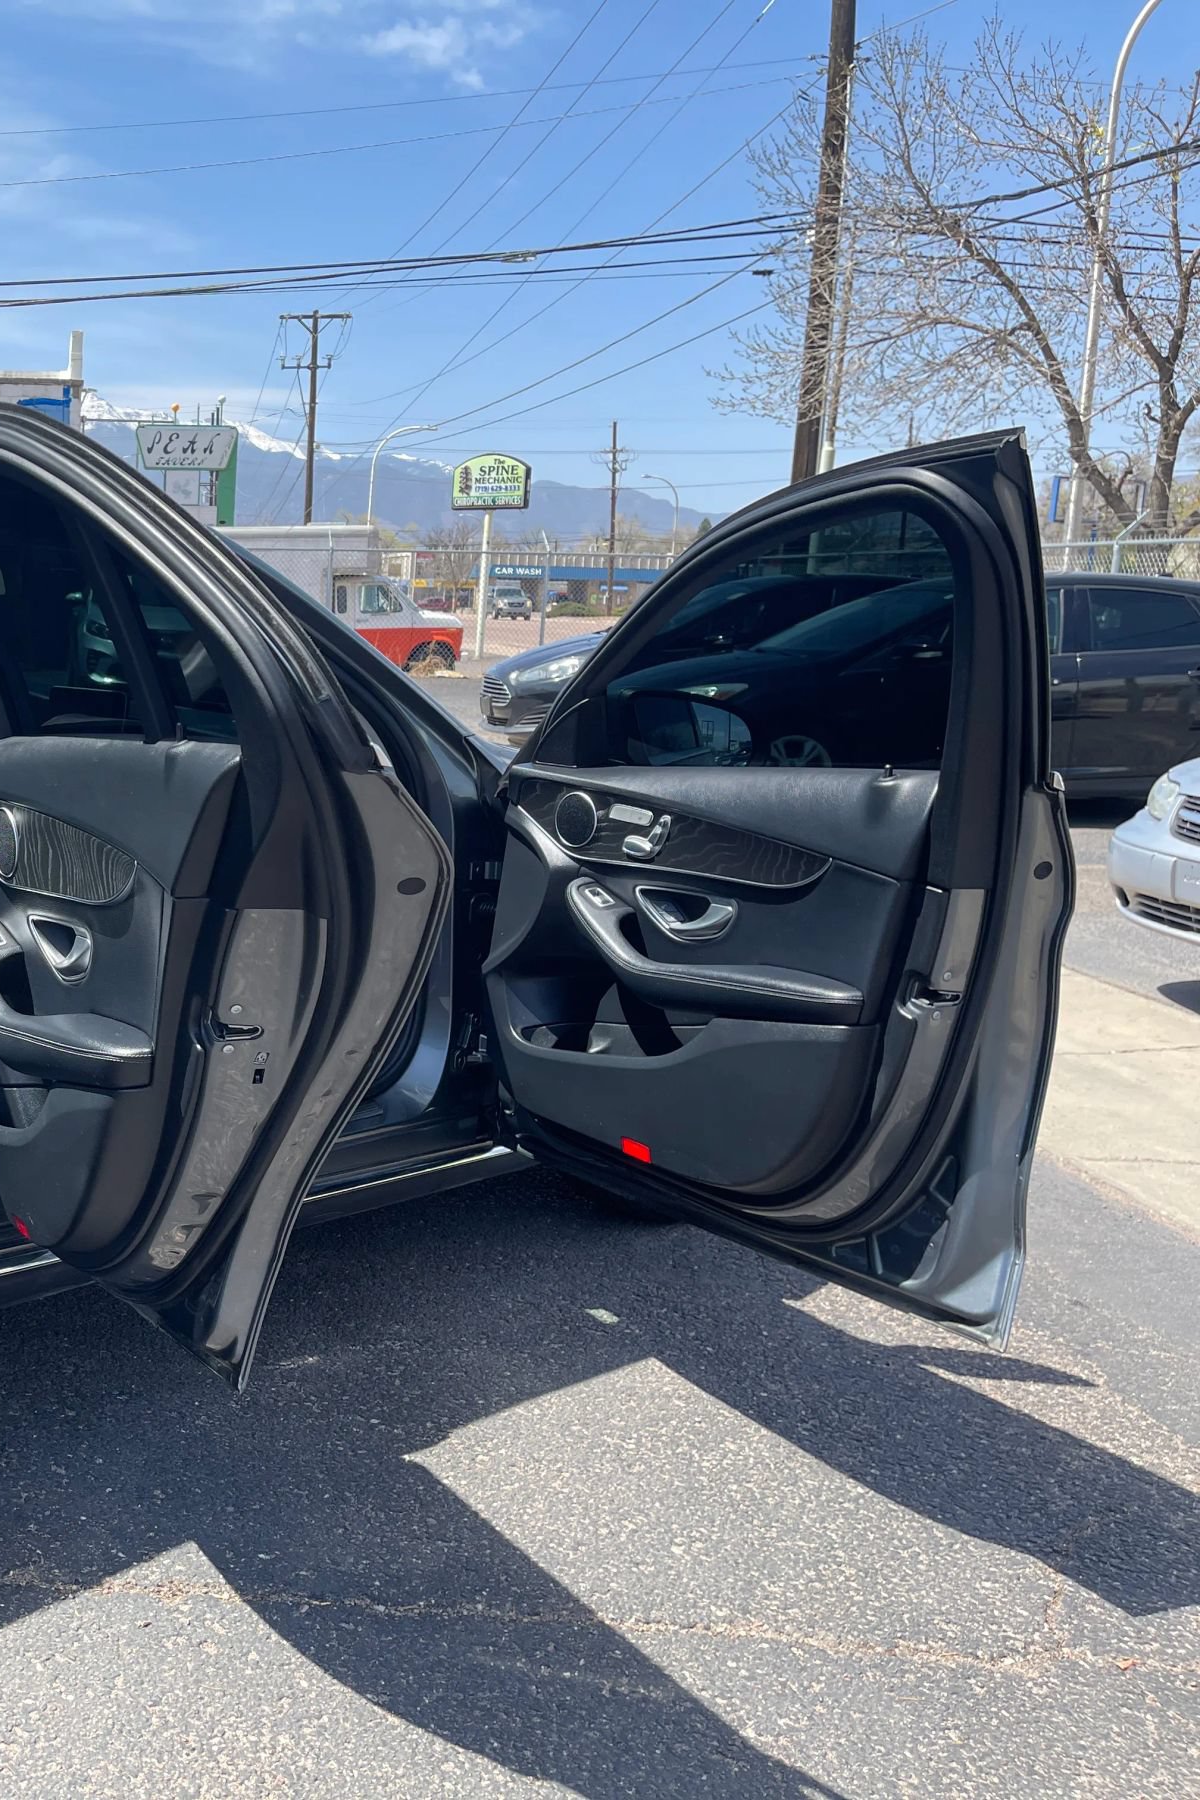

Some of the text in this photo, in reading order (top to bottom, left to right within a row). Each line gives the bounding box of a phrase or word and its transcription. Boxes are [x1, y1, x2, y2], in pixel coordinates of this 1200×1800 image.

[146, 430, 221, 455] PEAK
[155, 456, 208, 466] TAVERN
[479, 464, 520, 477] SPINE
[474, 476, 522, 485] MECHANIC
[474, 485, 490, 493] (719)
[454, 496, 521, 507] CHIROPRACTIC SERVICES
[495, 567, 543, 576] CAR WASH
